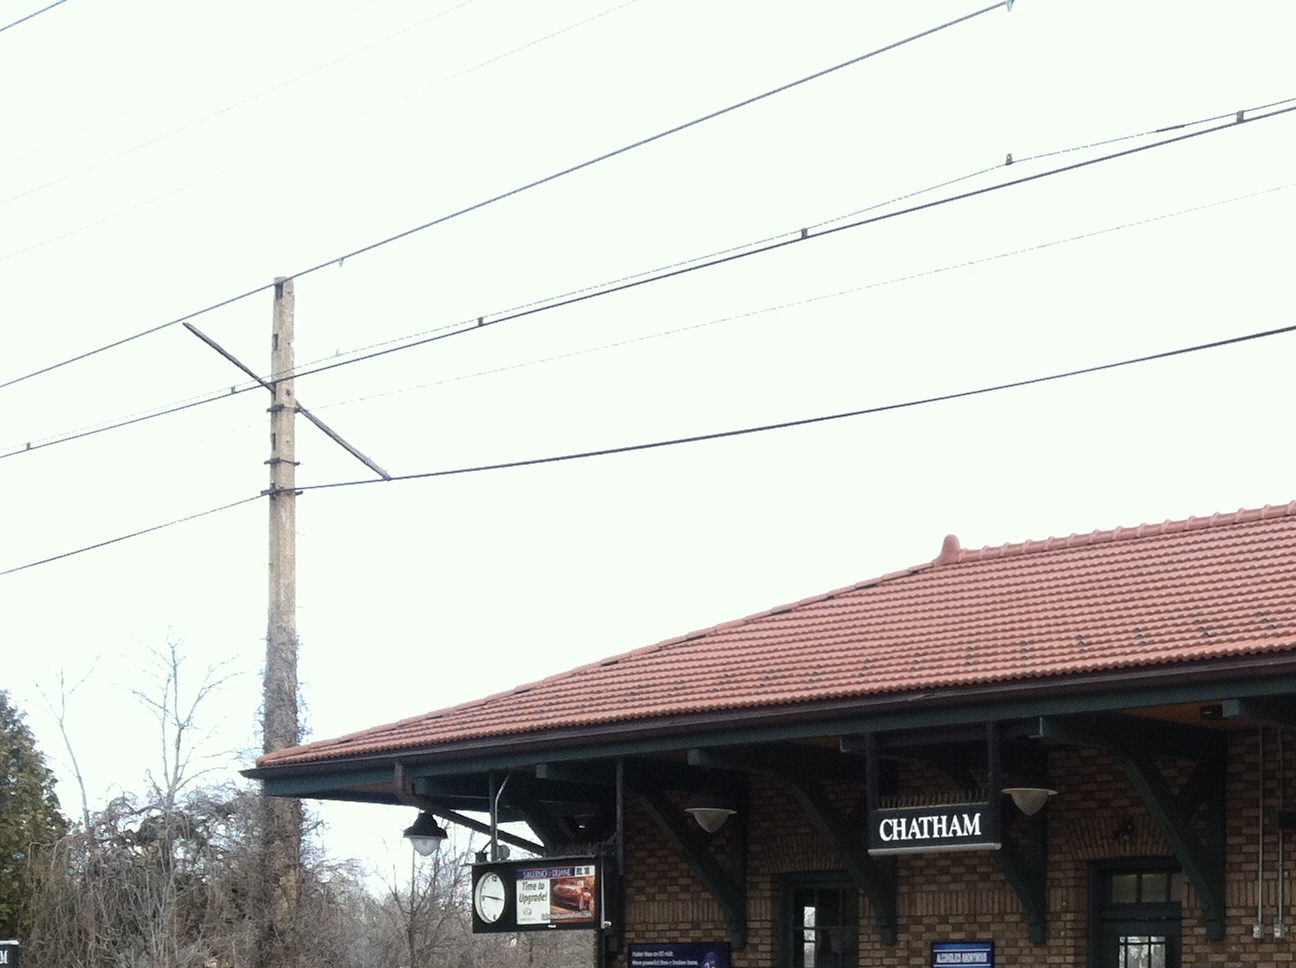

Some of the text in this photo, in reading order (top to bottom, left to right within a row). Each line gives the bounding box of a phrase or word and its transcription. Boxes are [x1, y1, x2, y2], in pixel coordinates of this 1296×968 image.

[879, 813, 982, 842] CHATHAM
[521, 882, 545, 891] Time to
[519, 892, 548, 905] Upgrade!
